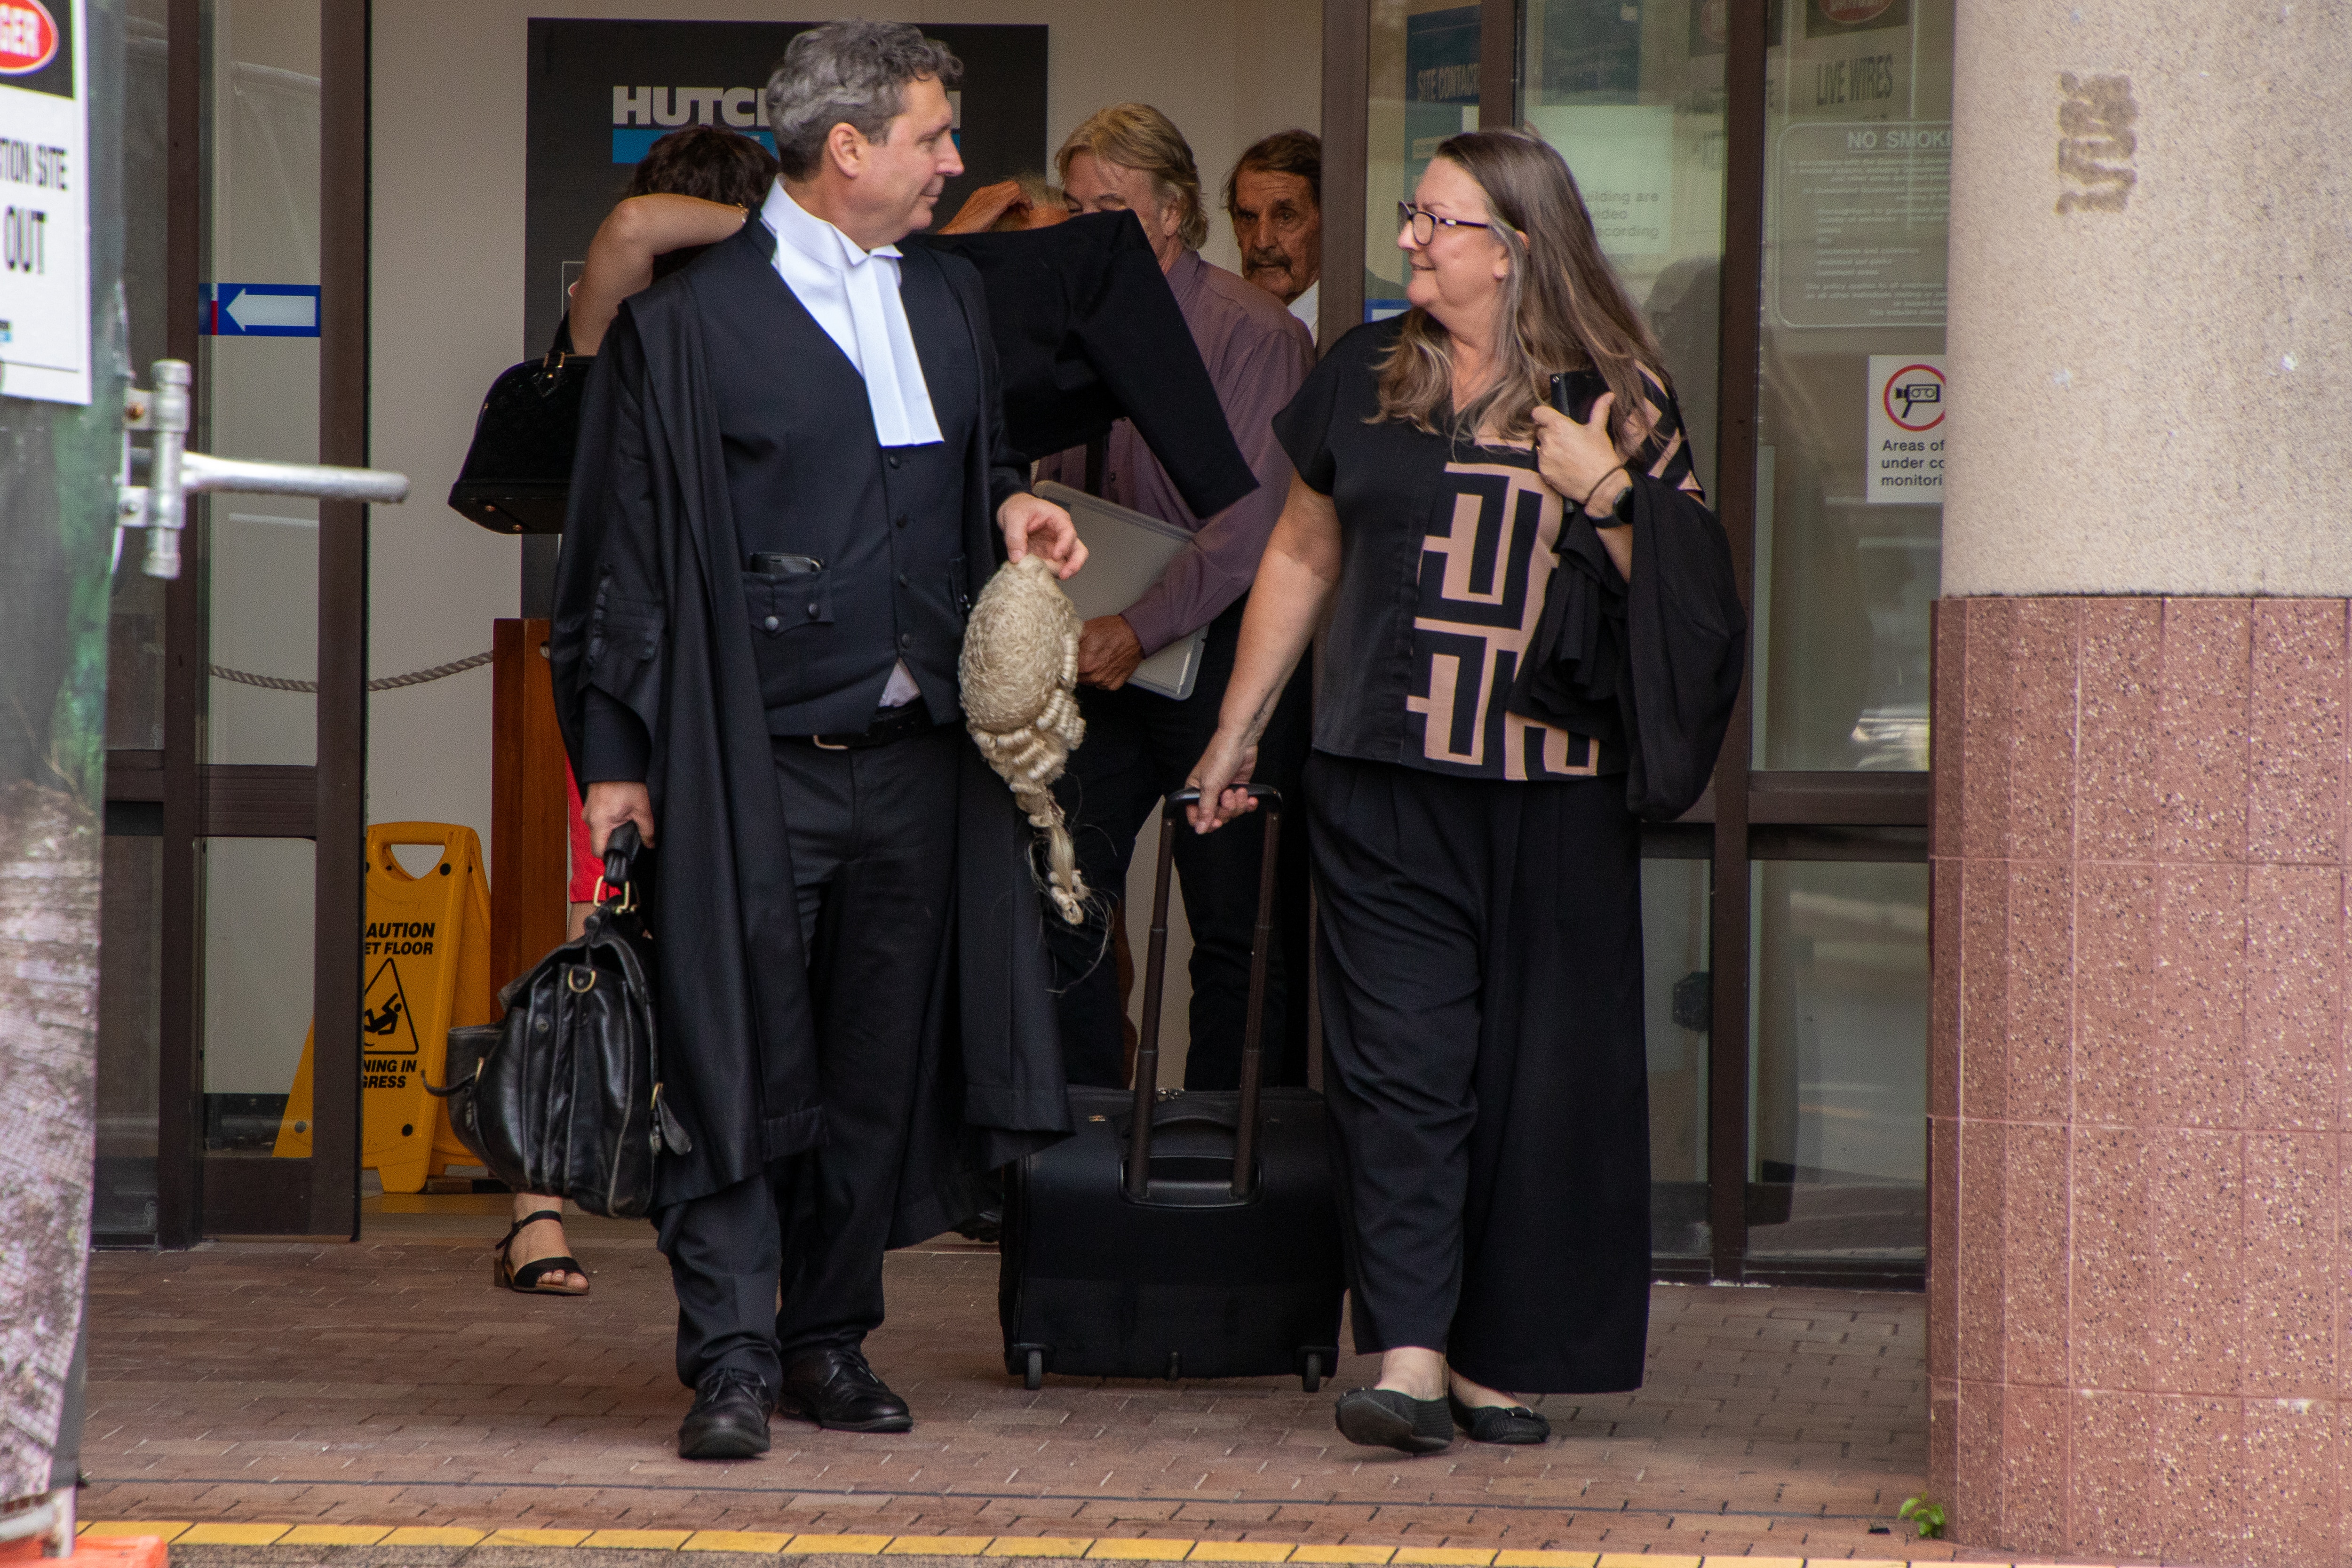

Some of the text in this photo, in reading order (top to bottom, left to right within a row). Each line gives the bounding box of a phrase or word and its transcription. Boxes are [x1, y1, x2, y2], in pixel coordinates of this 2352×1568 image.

[1417, 69, 1437, 102] SITE
[1817, 53, 1894, 106] LIVE WIRES
[1848, 130, 1951, 149] NO SMOKI
[35, 145, 68, 191] SITE
[1636, 192, 1659, 202] are
[3, 205, 48, 274] OUT
[1883, 439, 1945, 451] Areas of
[1882, 457, 1924, 469] under
[1882, 474, 1942, 486] monitori
[366, 922, 435, 938] AUTION
[384, 941, 433, 955] FLOOR
[400, 1059, 417, 1072] IN
